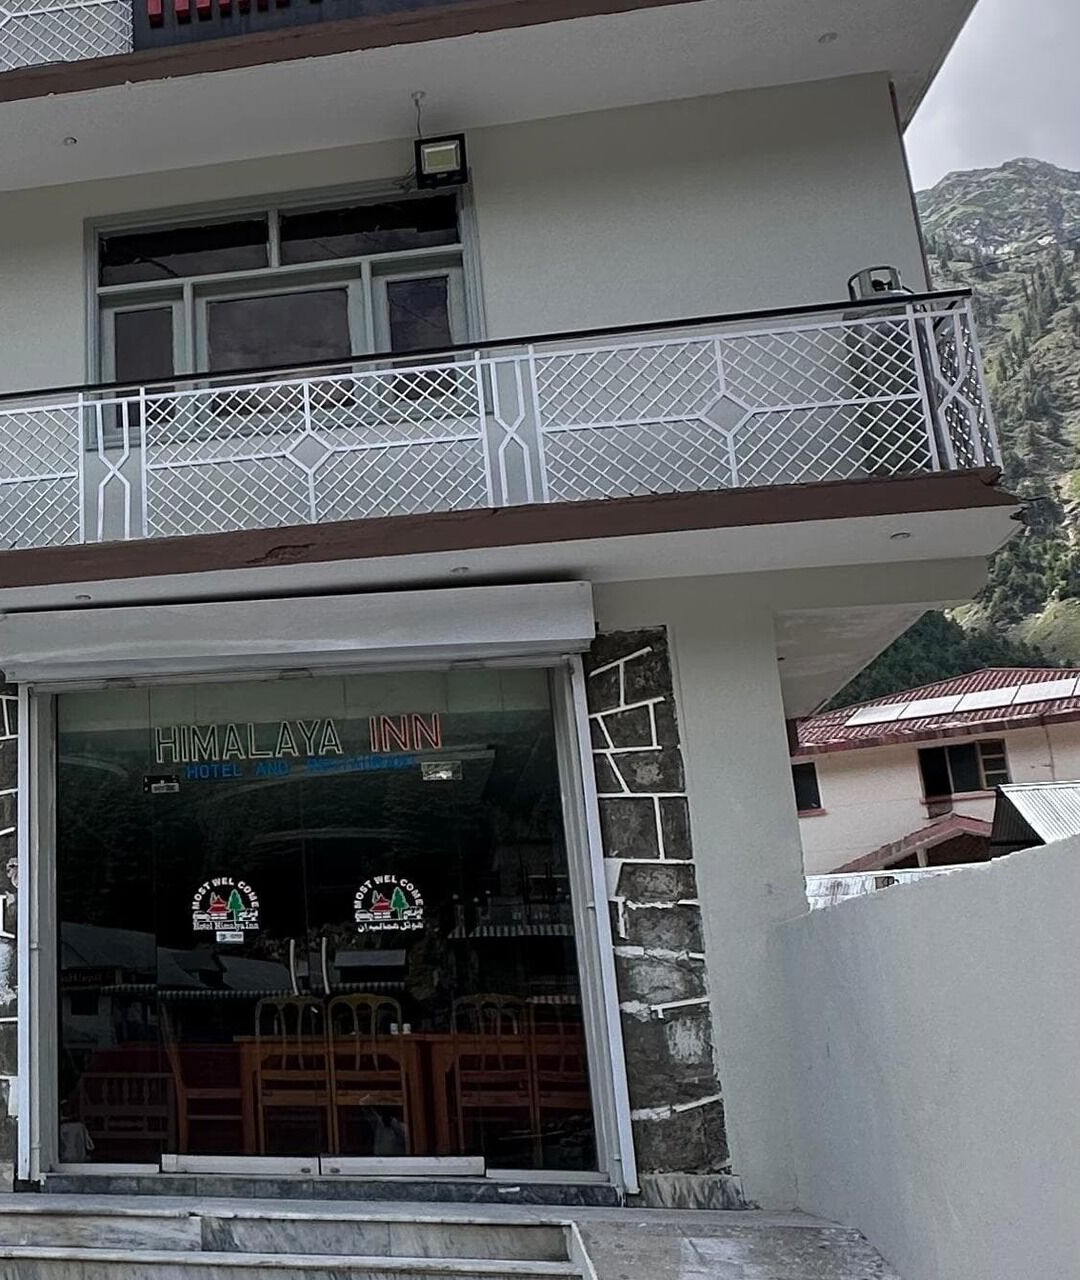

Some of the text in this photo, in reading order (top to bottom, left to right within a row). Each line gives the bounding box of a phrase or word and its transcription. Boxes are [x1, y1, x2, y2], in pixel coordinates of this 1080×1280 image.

[155, 719, 344, 764] HIMALAYA
[369, 712, 442, 753] INN
[185, 763, 243, 780] HOTEL
[255, 759, 291, 777] AND
[191, 881, 211, 910] MOST
[354, 880, 372, 909] MOST
